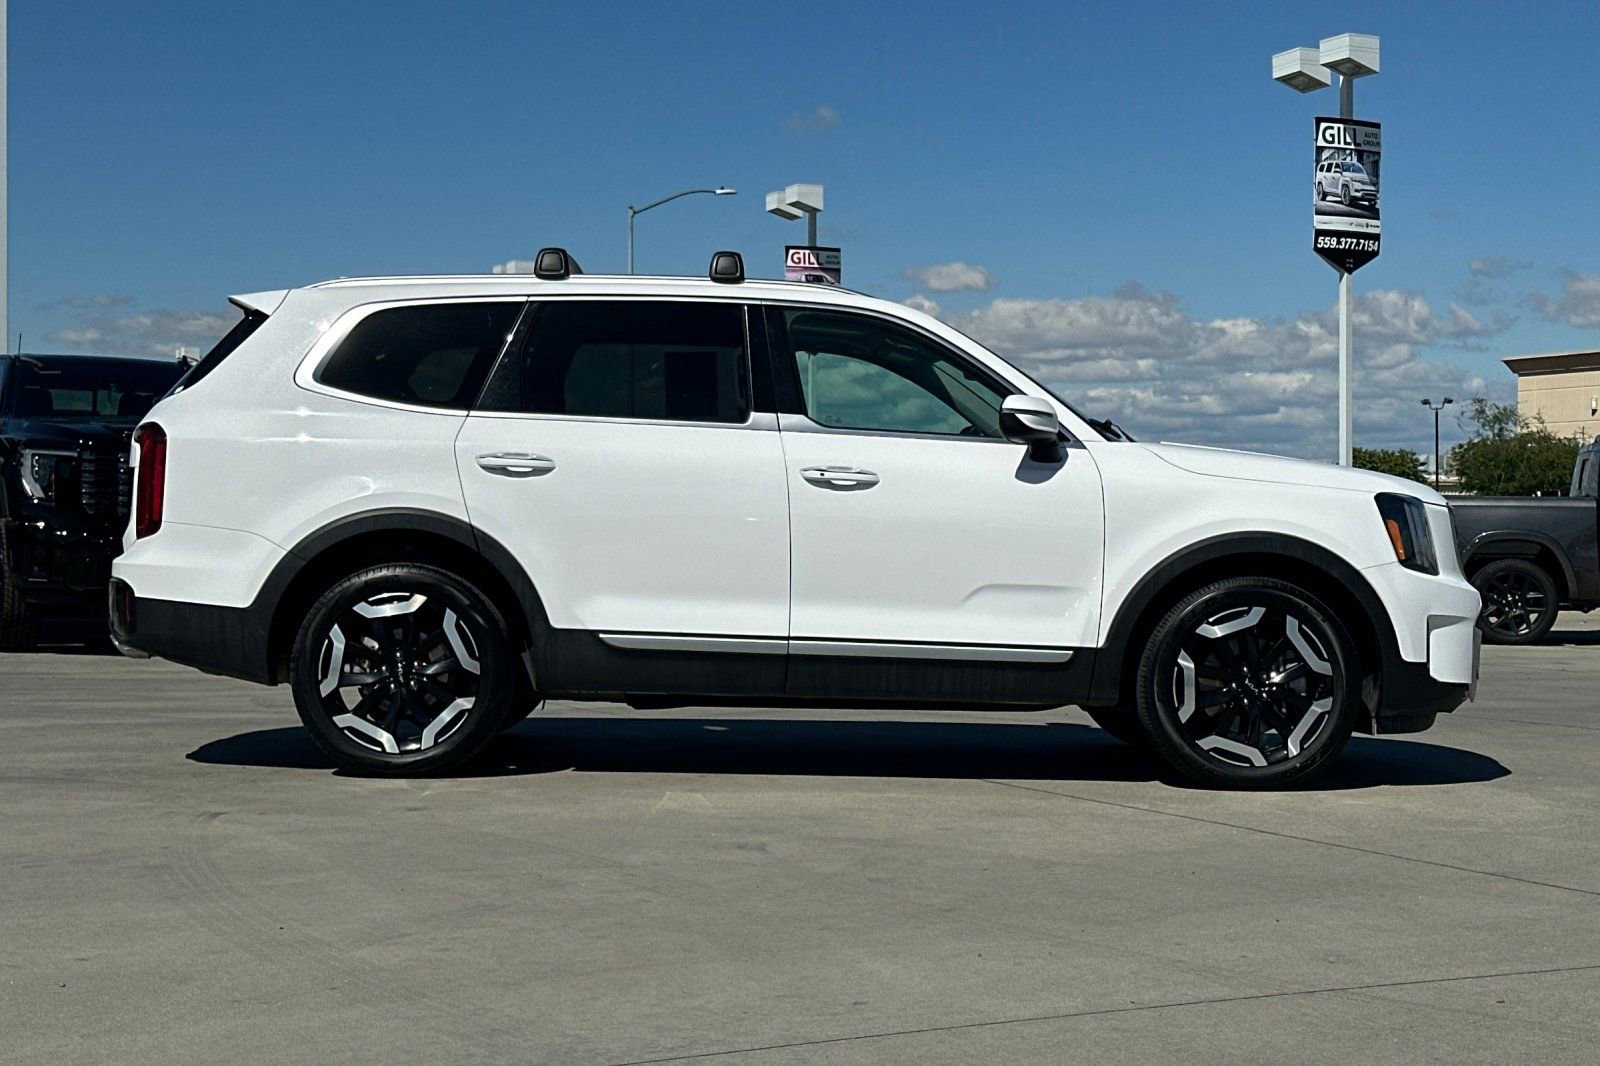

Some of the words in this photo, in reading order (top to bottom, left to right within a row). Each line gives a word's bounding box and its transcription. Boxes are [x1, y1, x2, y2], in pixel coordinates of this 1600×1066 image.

[1322, 125, 1361, 147] GILL
[1317, 237, 1379, 251] 559.377.7154
[791, 251, 824, 266] GILL
